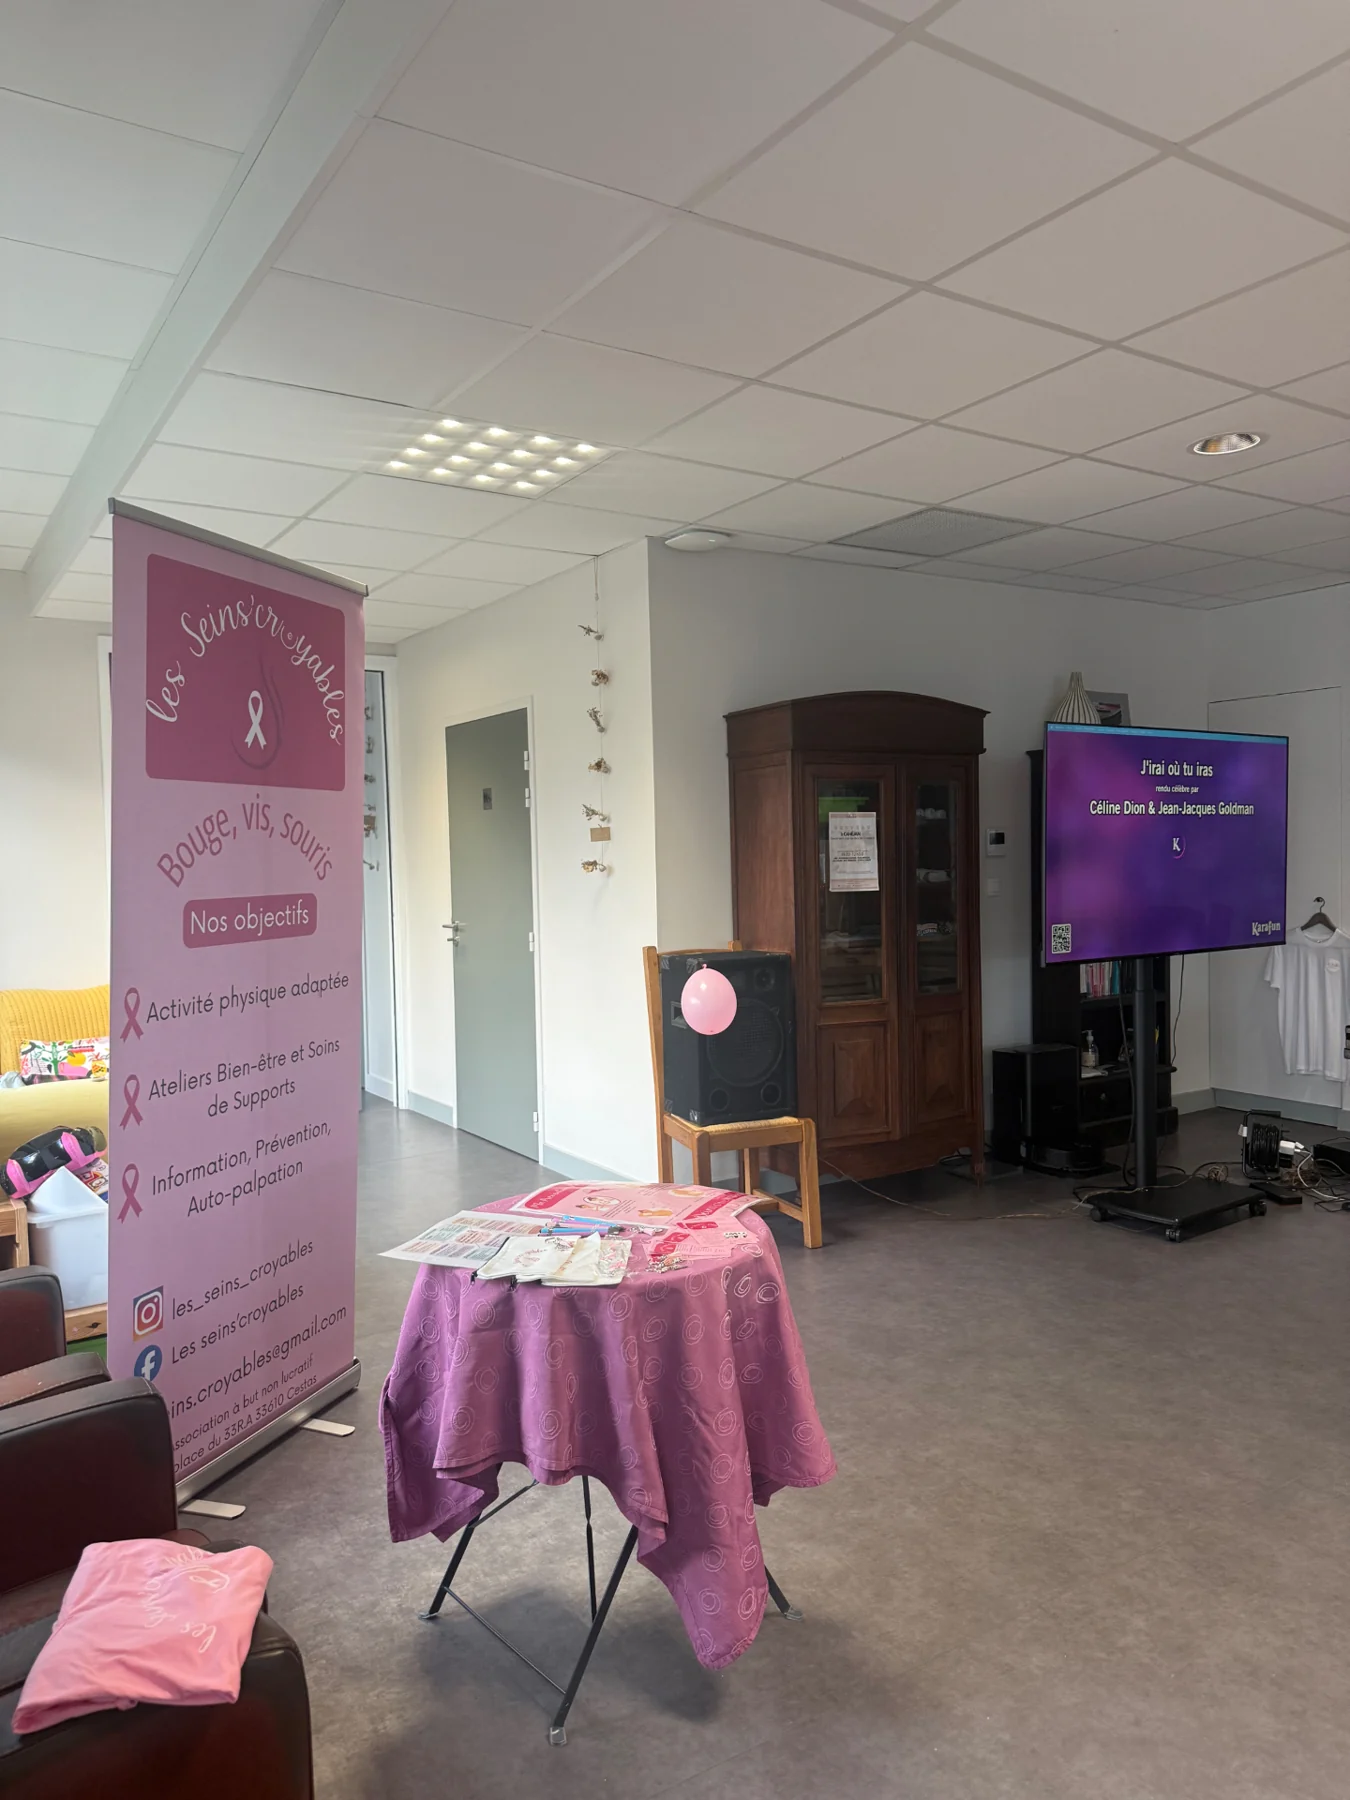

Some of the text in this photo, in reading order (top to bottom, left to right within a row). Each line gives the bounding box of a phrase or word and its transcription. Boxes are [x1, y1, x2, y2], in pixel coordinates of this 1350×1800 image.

[1140, 759, 1213, 777] J'irai où tu iras
[1155, 785, 1170, 793] rendu
[1191, 786, 1199, 794] par
[1089, 800, 1254, 818] Céline Dion & Jean-Jacques Goldman
[157, 793, 332, 888] Bouge, vis, souris
[190, 899, 309, 936] Nos objectifs
[1252, 921, 1281, 936] Karafun
[146, 971, 349, 1023] Activité physique adaptée
[148, 1037, 340, 1100] Ateliers Bien-être et Soins
[207, 1078, 296, 1117] de Supports
[152, 1121, 331, 1195] Information, Prévention,
[187, 1160, 303, 1217] Auto-palpation
[172, 1238, 313, 1320] les_seins_croyables
[172, 1283, 304, 1364] Les seins'croyables
[168, 1306, 347, 1419] ins.croyables@gmail.com
[174, 1353, 314, 1451] ssociation à but non lucratif
[208, 1433, 221, 1451] du
[256, 1394, 284, 1420] 33610
[287, 1374, 317, 1399] Cestas
